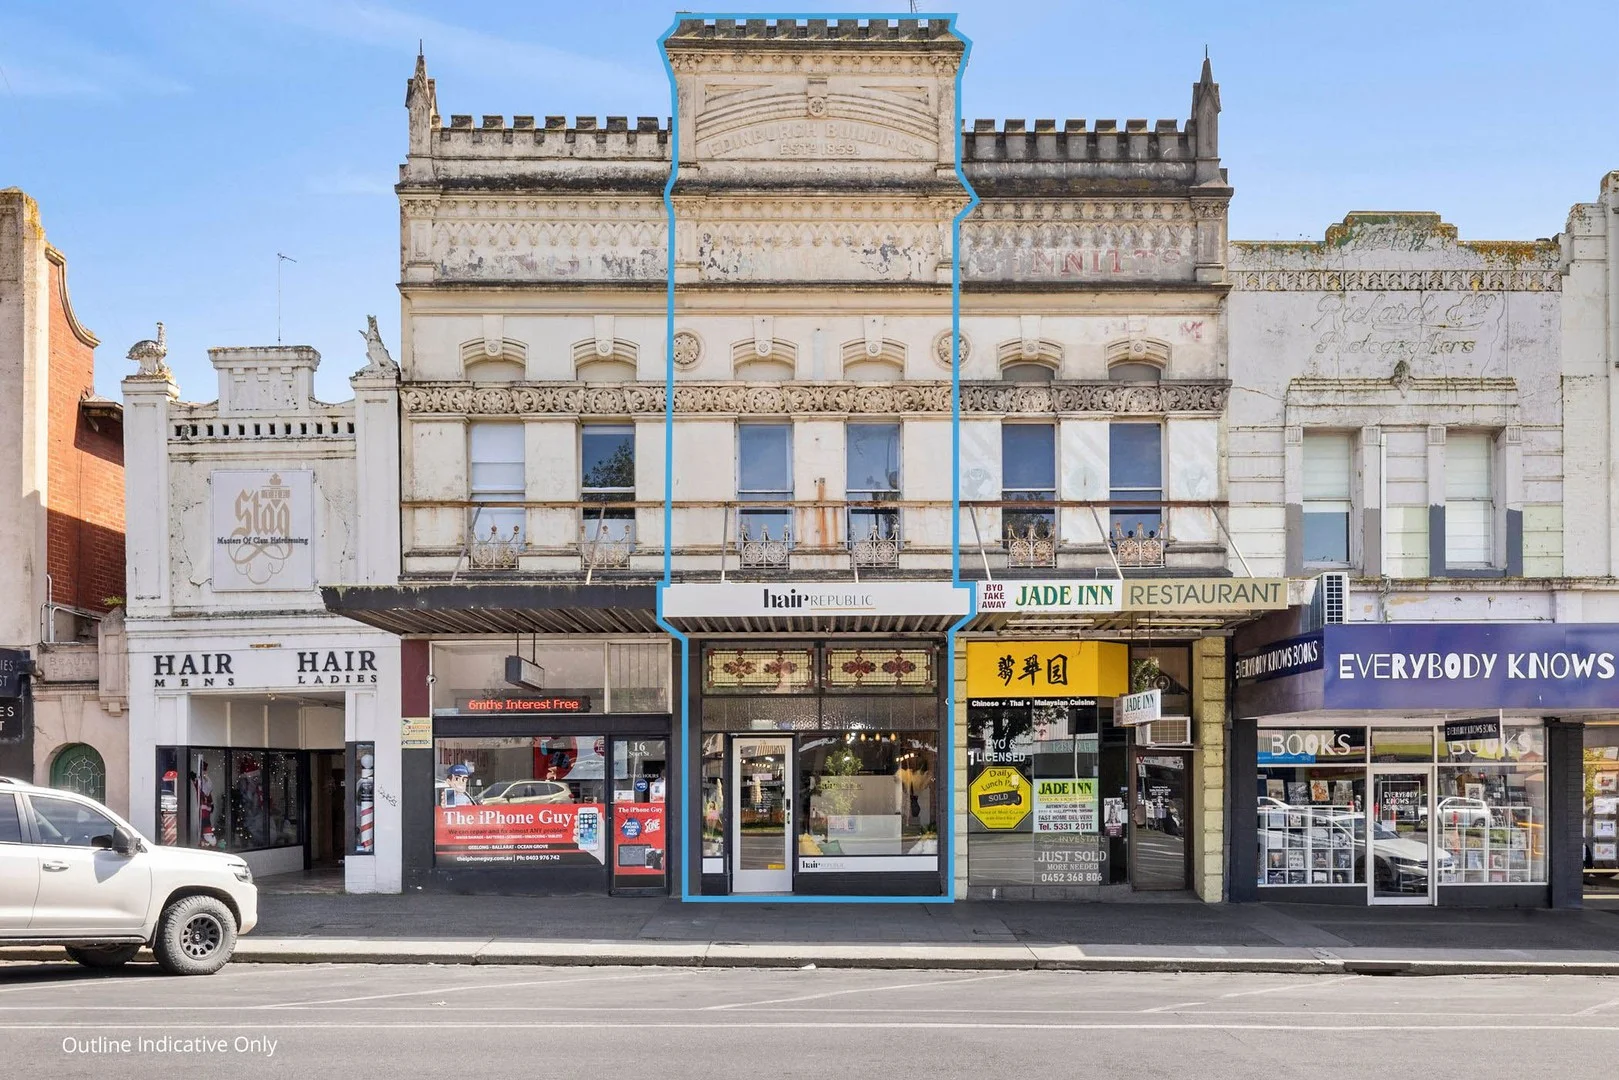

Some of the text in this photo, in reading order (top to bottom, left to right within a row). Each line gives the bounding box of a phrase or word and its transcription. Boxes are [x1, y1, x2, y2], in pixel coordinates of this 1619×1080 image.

[707, 122, 925, 157] EDINBURGH BUILDINGS
[1315, 331, 1476, 362] Photographers
[763, 588, 874, 608] hair REPUBLIC
[984, 592, 1004, 600] TAKE
[1015, 585, 1113, 606] JADE INN
[1130, 583, 1281, 605] RESTAURANT
[153, 653, 234, 676] HAIR
[297, 650, 378, 672] HAIR
[1235, 640, 1318, 679] EVERYBODY KNOWS BOOKS
[1339, 652, 1615, 679] EVERYBODY KNOWS
[155, 678, 235, 687] MENS
[298, 675, 377, 684] LADIES
[468, 699, 579, 709] 6mths Interest Free
[1034, 699, 1068, 707] Malaysian
[1125, 696, 1141, 712] JADE
[1142, 693, 1154, 709] INN
[633, 742, 646, 752] 16
[1271, 734, 1351, 756] BOOKS
[976, 752, 1025, 762] LICENSED
[989, 769, 1012, 778] Daily
[981, 779, 1003, 791] Lunch
[1038, 782, 1092, 795] JADE INN
[988, 793, 1009, 802] SOLD
[443, 810, 573, 827] The iPhone Guy
[1038, 823, 1052, 831] Tel.
[1060, 835, 1106, 843] INVESTATE
[1038, 850, 1107, 863] JUST SOLD
[802, 860, 821, 869] hair
[1070, 862, 1099, 870] NEEDED
[1041, 872, 1103, 882] 0452 368 806
